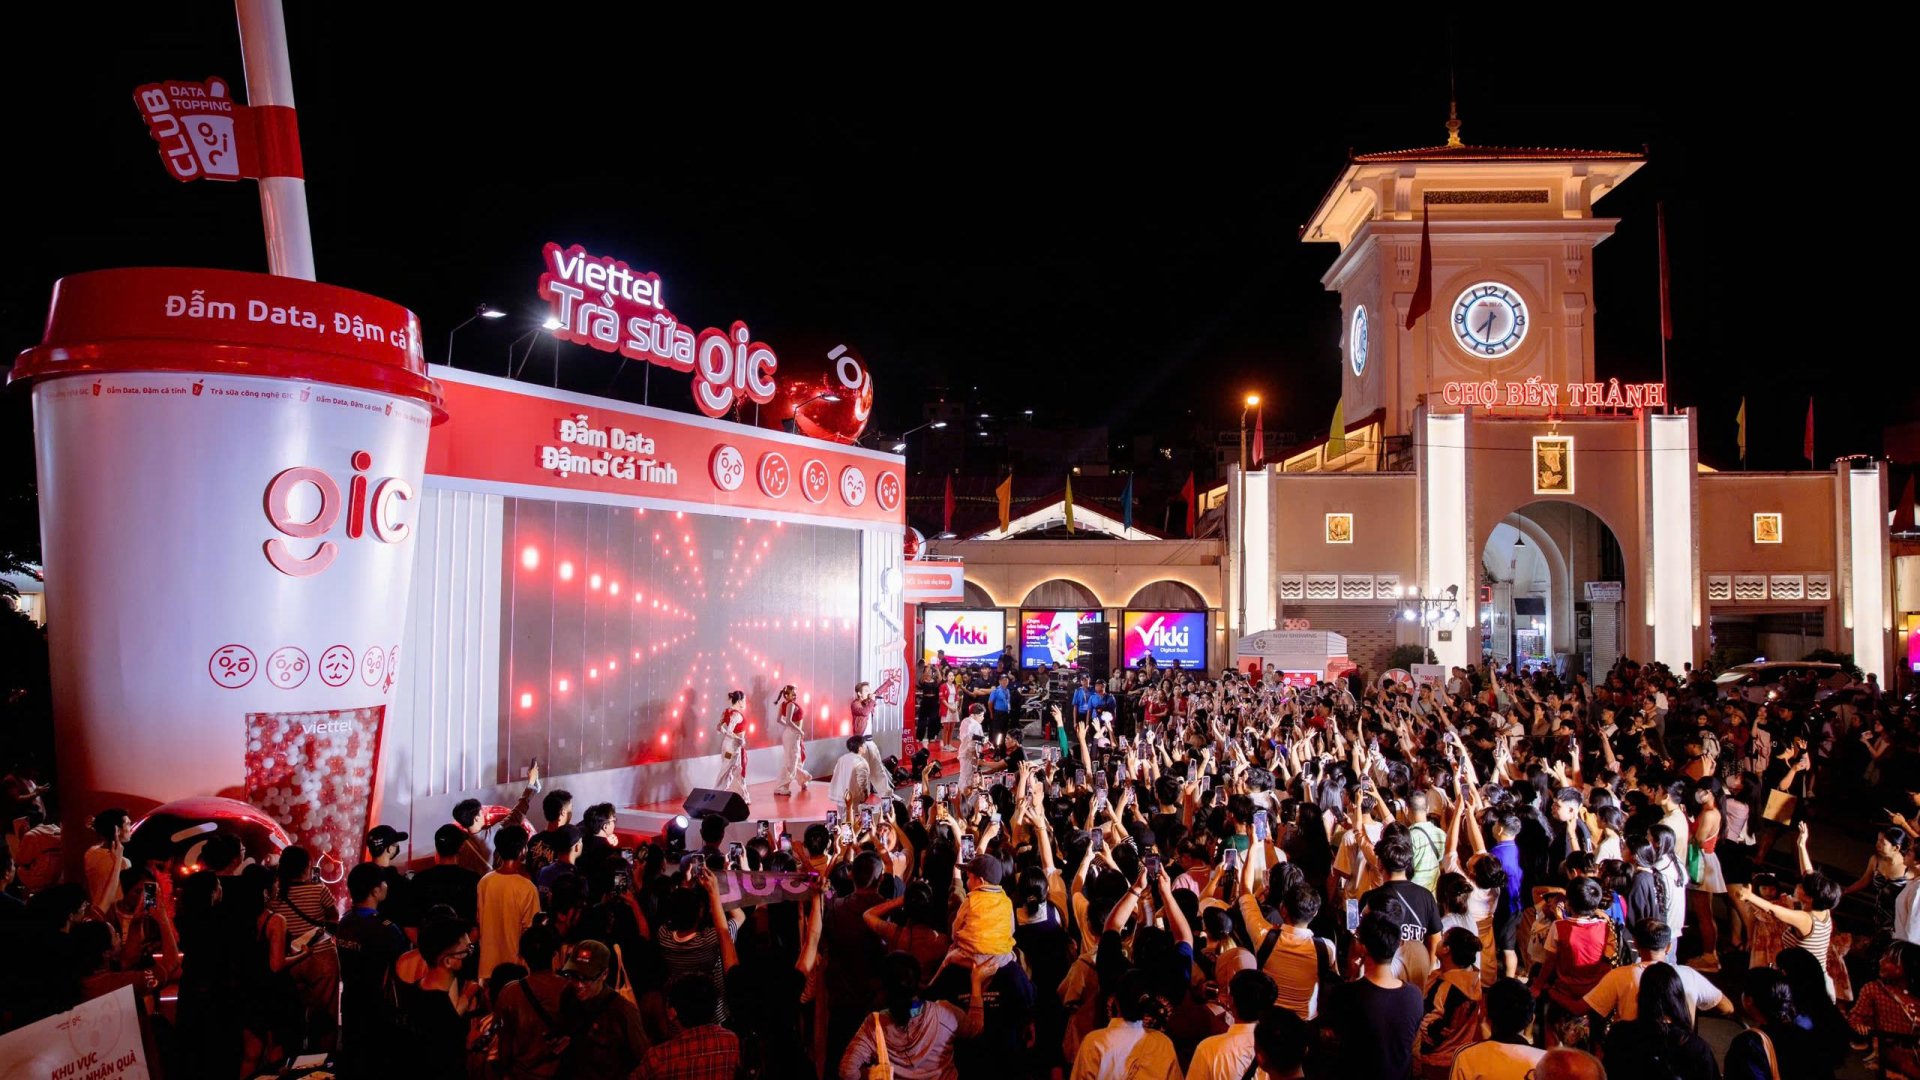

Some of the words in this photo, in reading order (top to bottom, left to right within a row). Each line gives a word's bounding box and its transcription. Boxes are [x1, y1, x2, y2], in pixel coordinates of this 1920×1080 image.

[170, 86, 206, 98] DATA
[172, 99, 232, 112] TOPPING
[142, 88, 198, 176] CLUB
[553, 250, 664, 310] viettel
[1482, 286, 1498, 296] 12
[165, 289, 236, 320] Đẫm
[248, 300, 325, 334] Data,
[333, 312, 385, 343] Đậm
[390, 328, 407, 350] cá
[550, 281, 620, 343] Trà
[627, 313, 696, 365] sữa
[1455, 314, 1464, 324] 9
[1516, 315, 1525, 326] 3
[1486, 345, 1495, 355] 6
[699, 327, 777, 410] gic
[1442, 379, 1498, 409] CHỢ
[1506, 376, 1559, 407] BẾN
[1567, 377, 1664, 408] THÀNH
[559, 414, 608, 448] Đẫm
[610, 428, 655, 455] Data
[541, 446, 591, 478] Đậm
[610, 456, 636, 480] Cá
[637, 459, 678, 485] Tính
[263, 449, 414, 577] gic
[936, 615, 988, 644] Vikki
[1134, 616, 1189, 646] Vikki
[302, 720, 352, 734] viettel
[51, 1062, 75, 1080] KHU
[77, 1052, 98, 1070] VỰC
